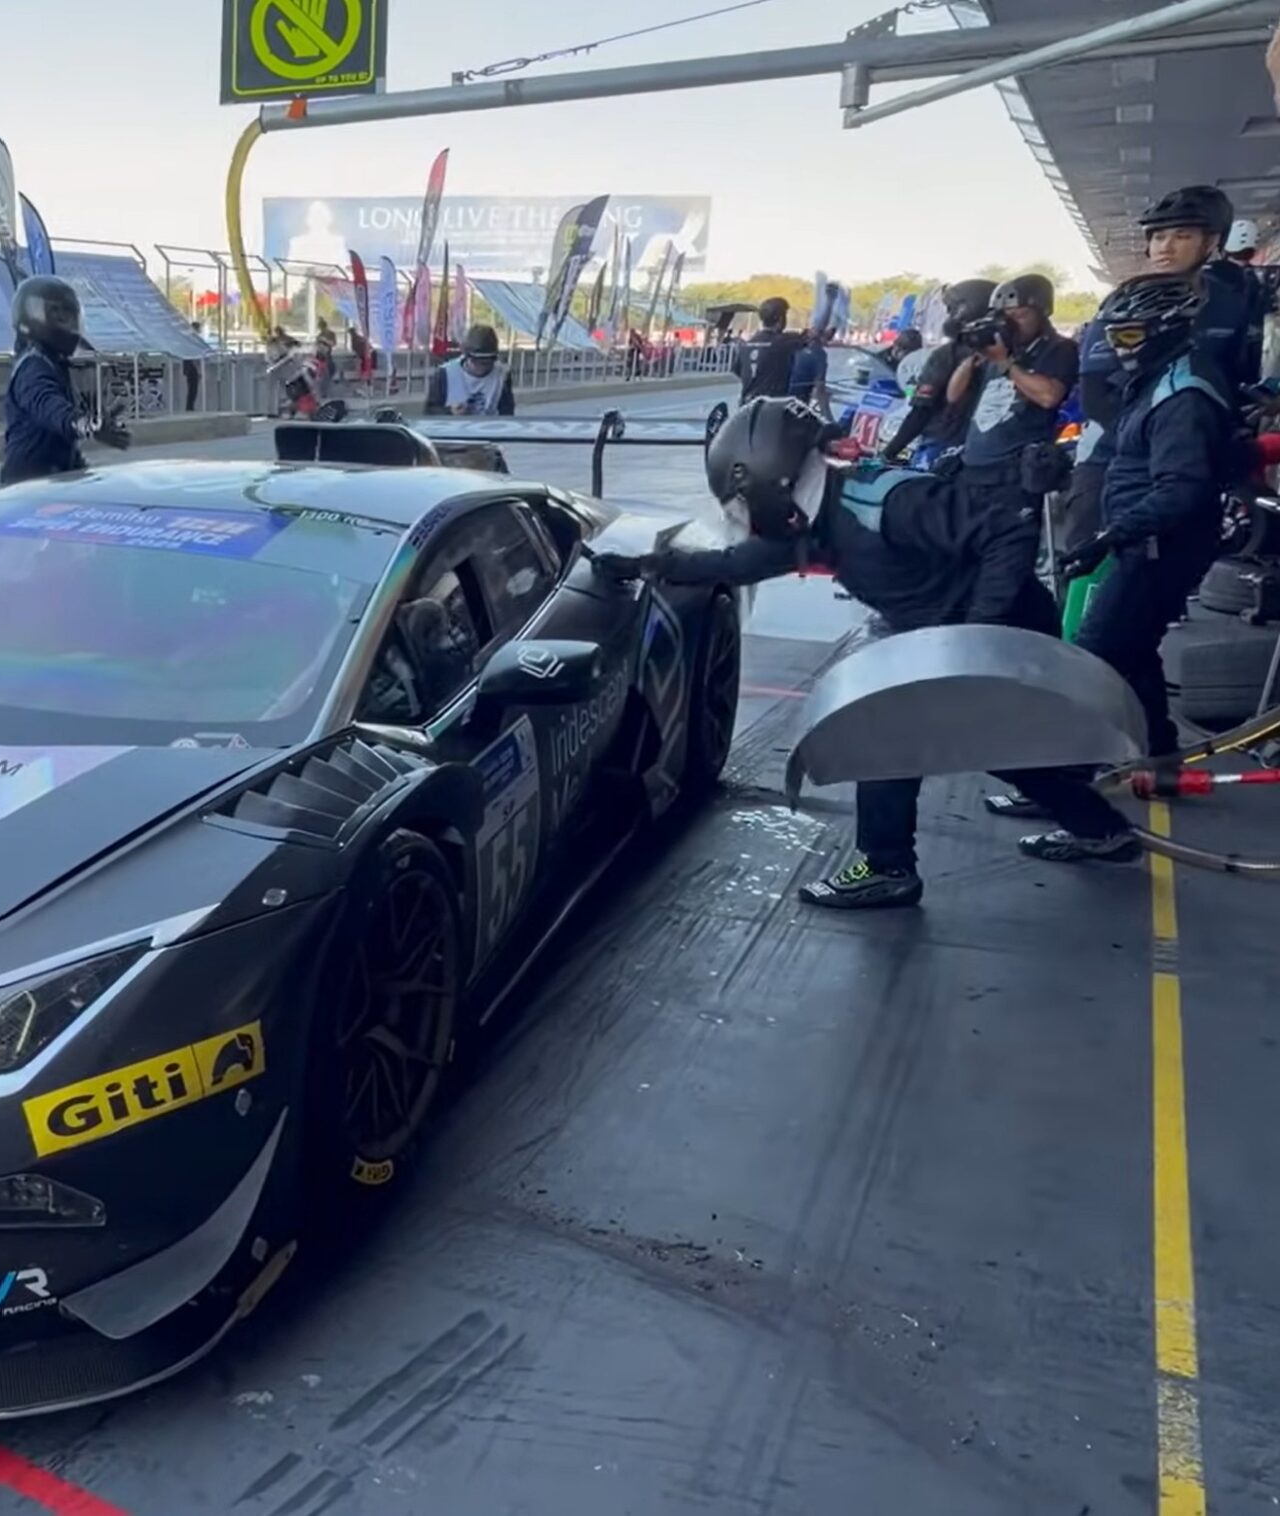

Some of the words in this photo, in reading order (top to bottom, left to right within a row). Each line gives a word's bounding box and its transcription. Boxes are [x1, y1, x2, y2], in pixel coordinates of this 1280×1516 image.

[443, 205, 500, 230] LIVE
[68, 504, 161, 523] idemitsu
[77, 522, 232, 546] ENDURANCE
[47, 1062, 188, 1137] Giti
